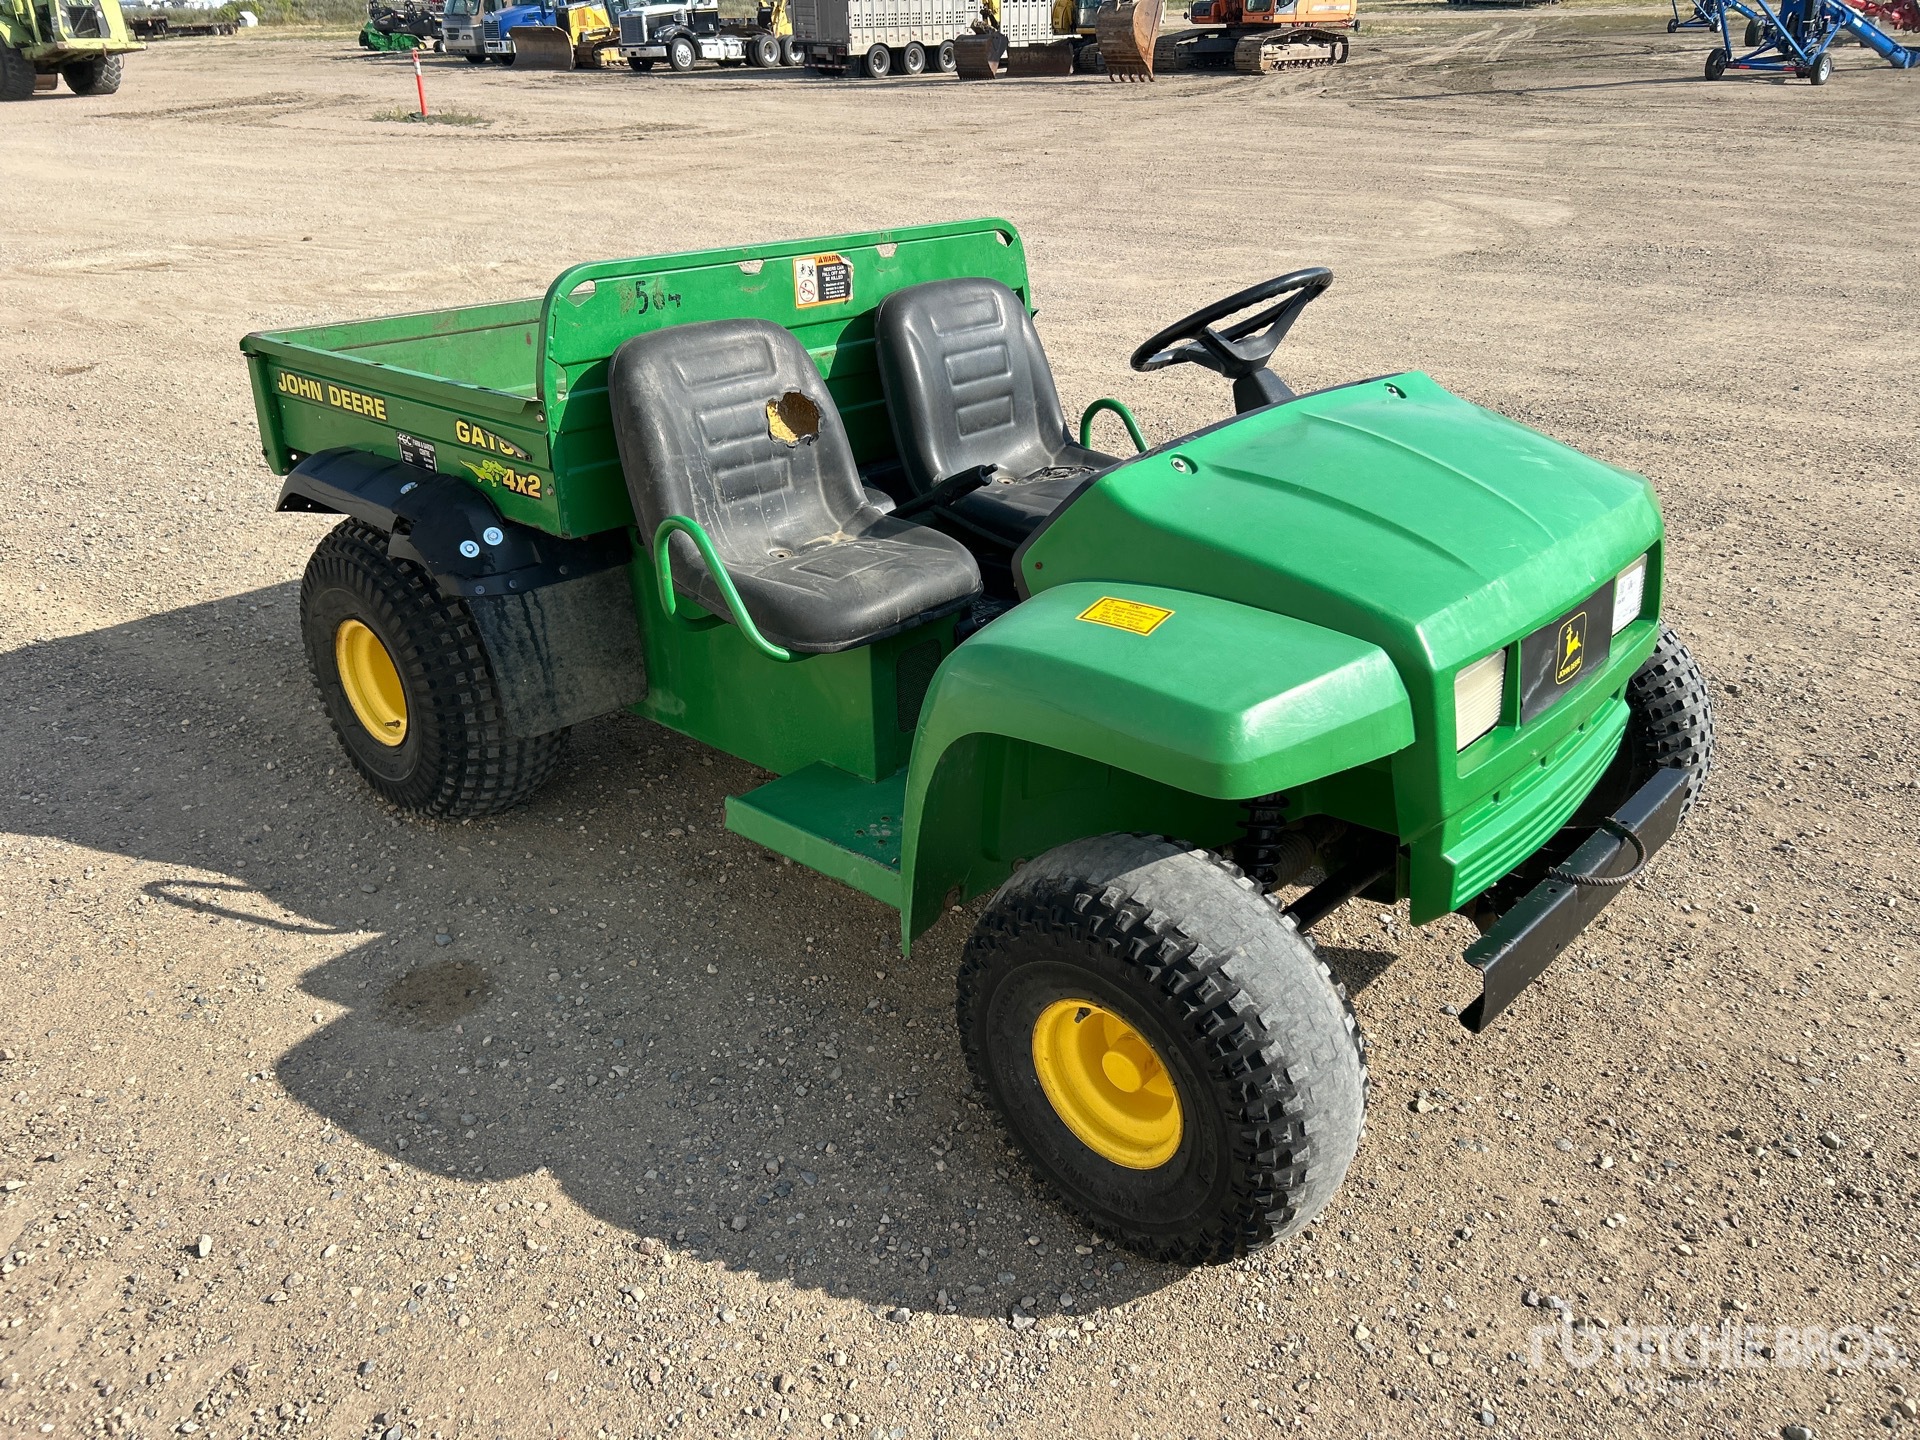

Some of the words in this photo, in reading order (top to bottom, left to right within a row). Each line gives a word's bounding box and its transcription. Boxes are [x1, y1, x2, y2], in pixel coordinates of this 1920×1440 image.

[278, 372, 323, 402] JOHN
[328, 385, 387, 420] DEERE
[502, 468, 541, 498] 4x2
[1557, 665, 1570, 679] JOHN
[1570, 656, 1581, 671] DEERE
